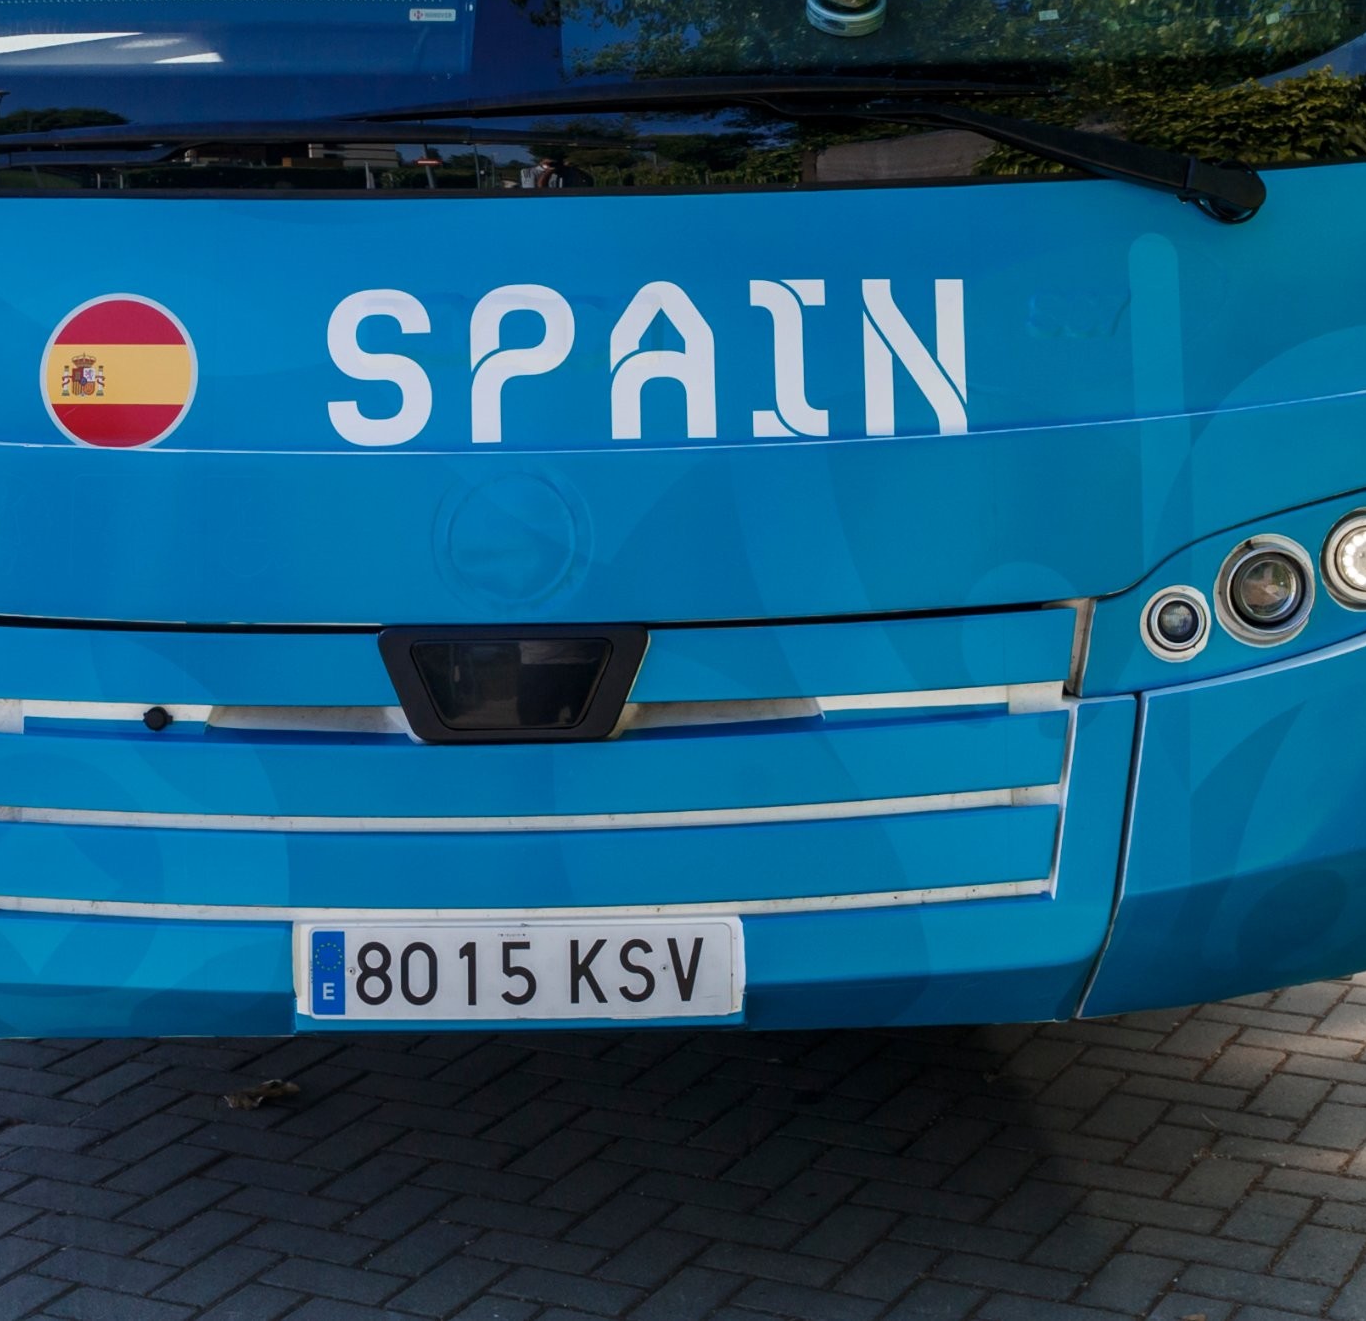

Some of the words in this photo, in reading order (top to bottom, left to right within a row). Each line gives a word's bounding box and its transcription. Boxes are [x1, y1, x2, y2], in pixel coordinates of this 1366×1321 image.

[327, 278, 968, 446] SPAIN
[323, 982, 335, 1000] E
[356, 941, 537, 1006] 8015
[570, 937, 704, 1004] KSV
